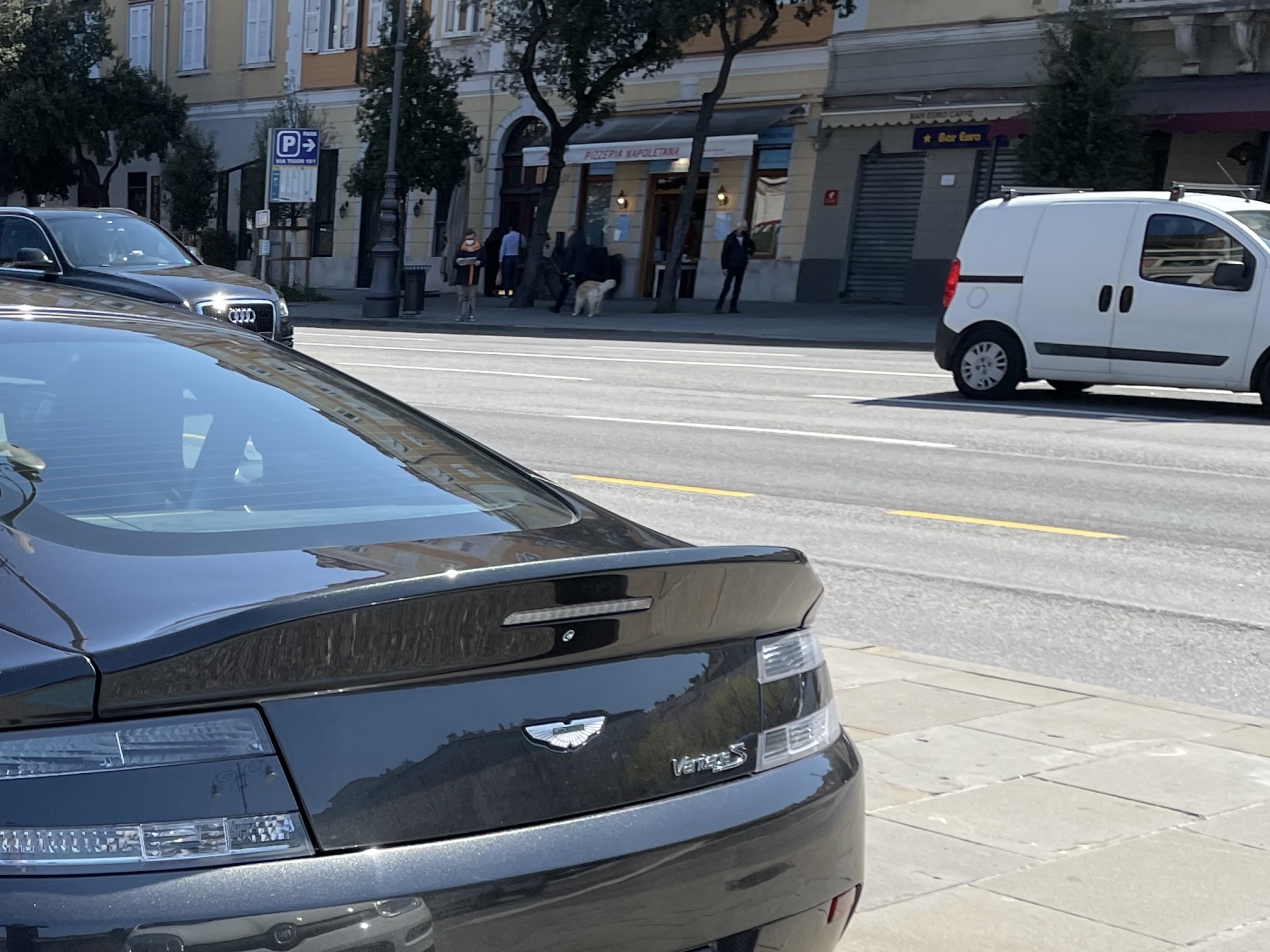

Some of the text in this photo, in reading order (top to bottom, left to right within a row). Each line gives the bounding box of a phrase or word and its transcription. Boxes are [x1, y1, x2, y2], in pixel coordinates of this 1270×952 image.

[283, 135, 296, 153] P
[584, 147, 680, 160] PIZZERIA NAPOLETANA
